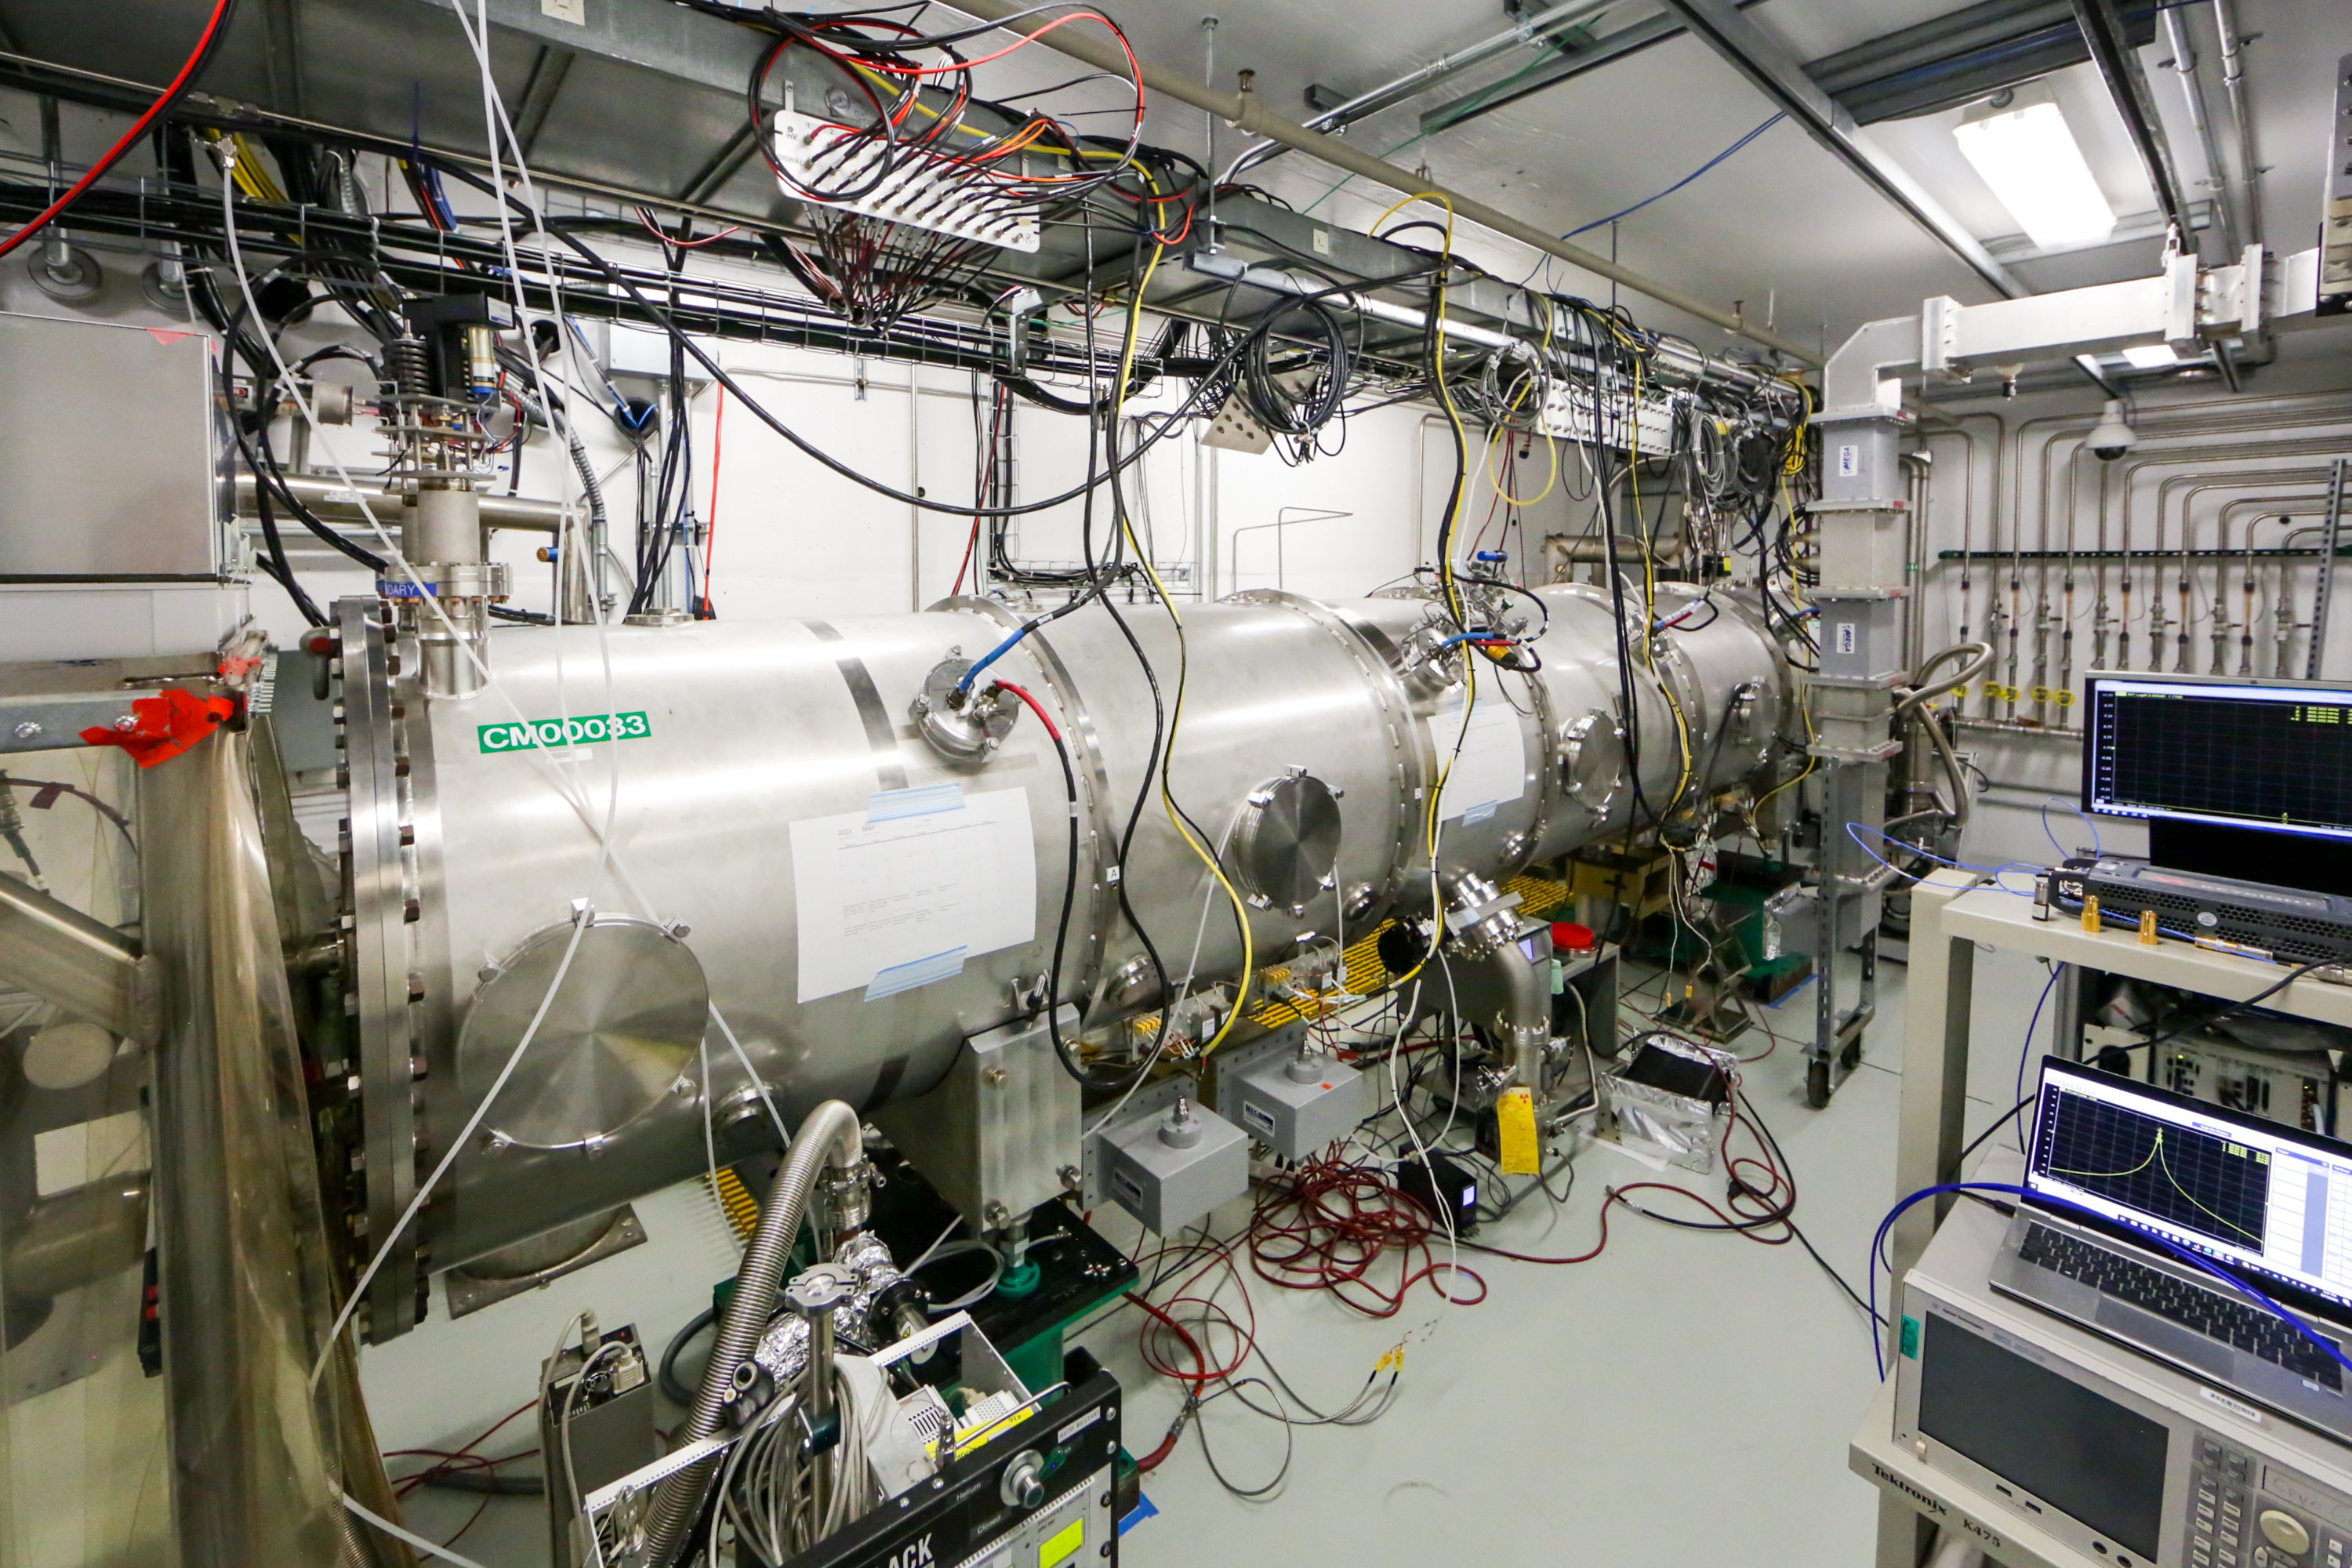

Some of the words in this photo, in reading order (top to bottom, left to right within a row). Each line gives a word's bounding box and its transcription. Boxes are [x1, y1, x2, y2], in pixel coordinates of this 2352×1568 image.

[483, 715, 647, 749] CM00033
[1111, 869, 1117, 878] A
[1059, 1426, 1074, 1439] AUTO
[956, 1483, 981, 1501] Helium
[1872, 1463, 1947, 1515] Tektronix
[1962, 1519, 2001, 1548] K475
[977, 1514, 1002, 1534] Closed
